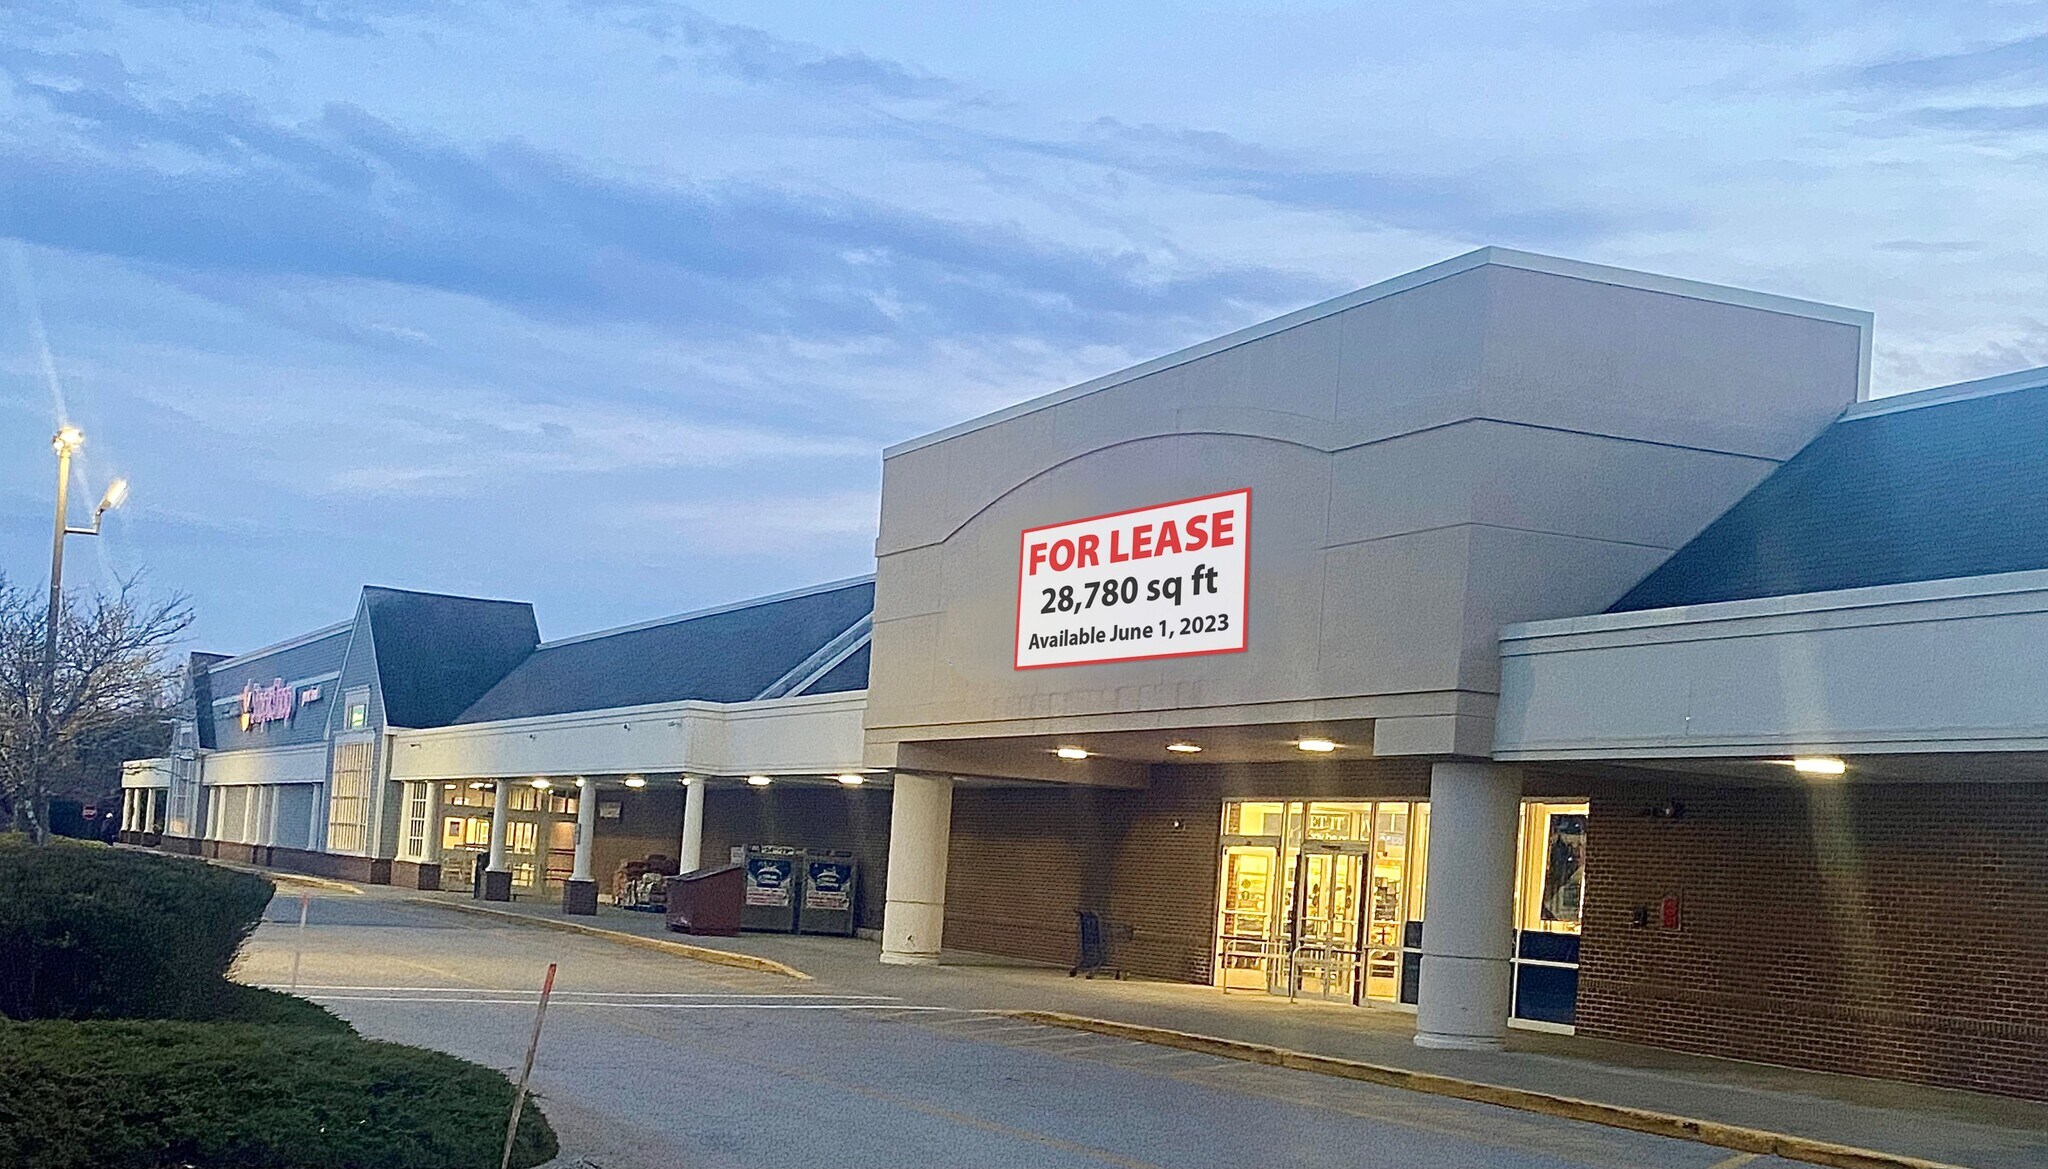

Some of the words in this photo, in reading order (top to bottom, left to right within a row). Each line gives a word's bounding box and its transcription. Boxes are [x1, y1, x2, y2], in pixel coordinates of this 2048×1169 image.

[1029, 534, 1100, 576] FOR
[1109, 509, 1235, 564] LEASE
[1040, 576, 1139, 615] 28,780
[1146, 576, 1182, 606] sq
[1191, 563, 1219, 596] ft
[1028, 626, 1106, 650] Available
[1109, 624, 1154, 643] June
[1159, 619, 1175, 640] 1,
[1179, 613, 1230, 636] 2023
